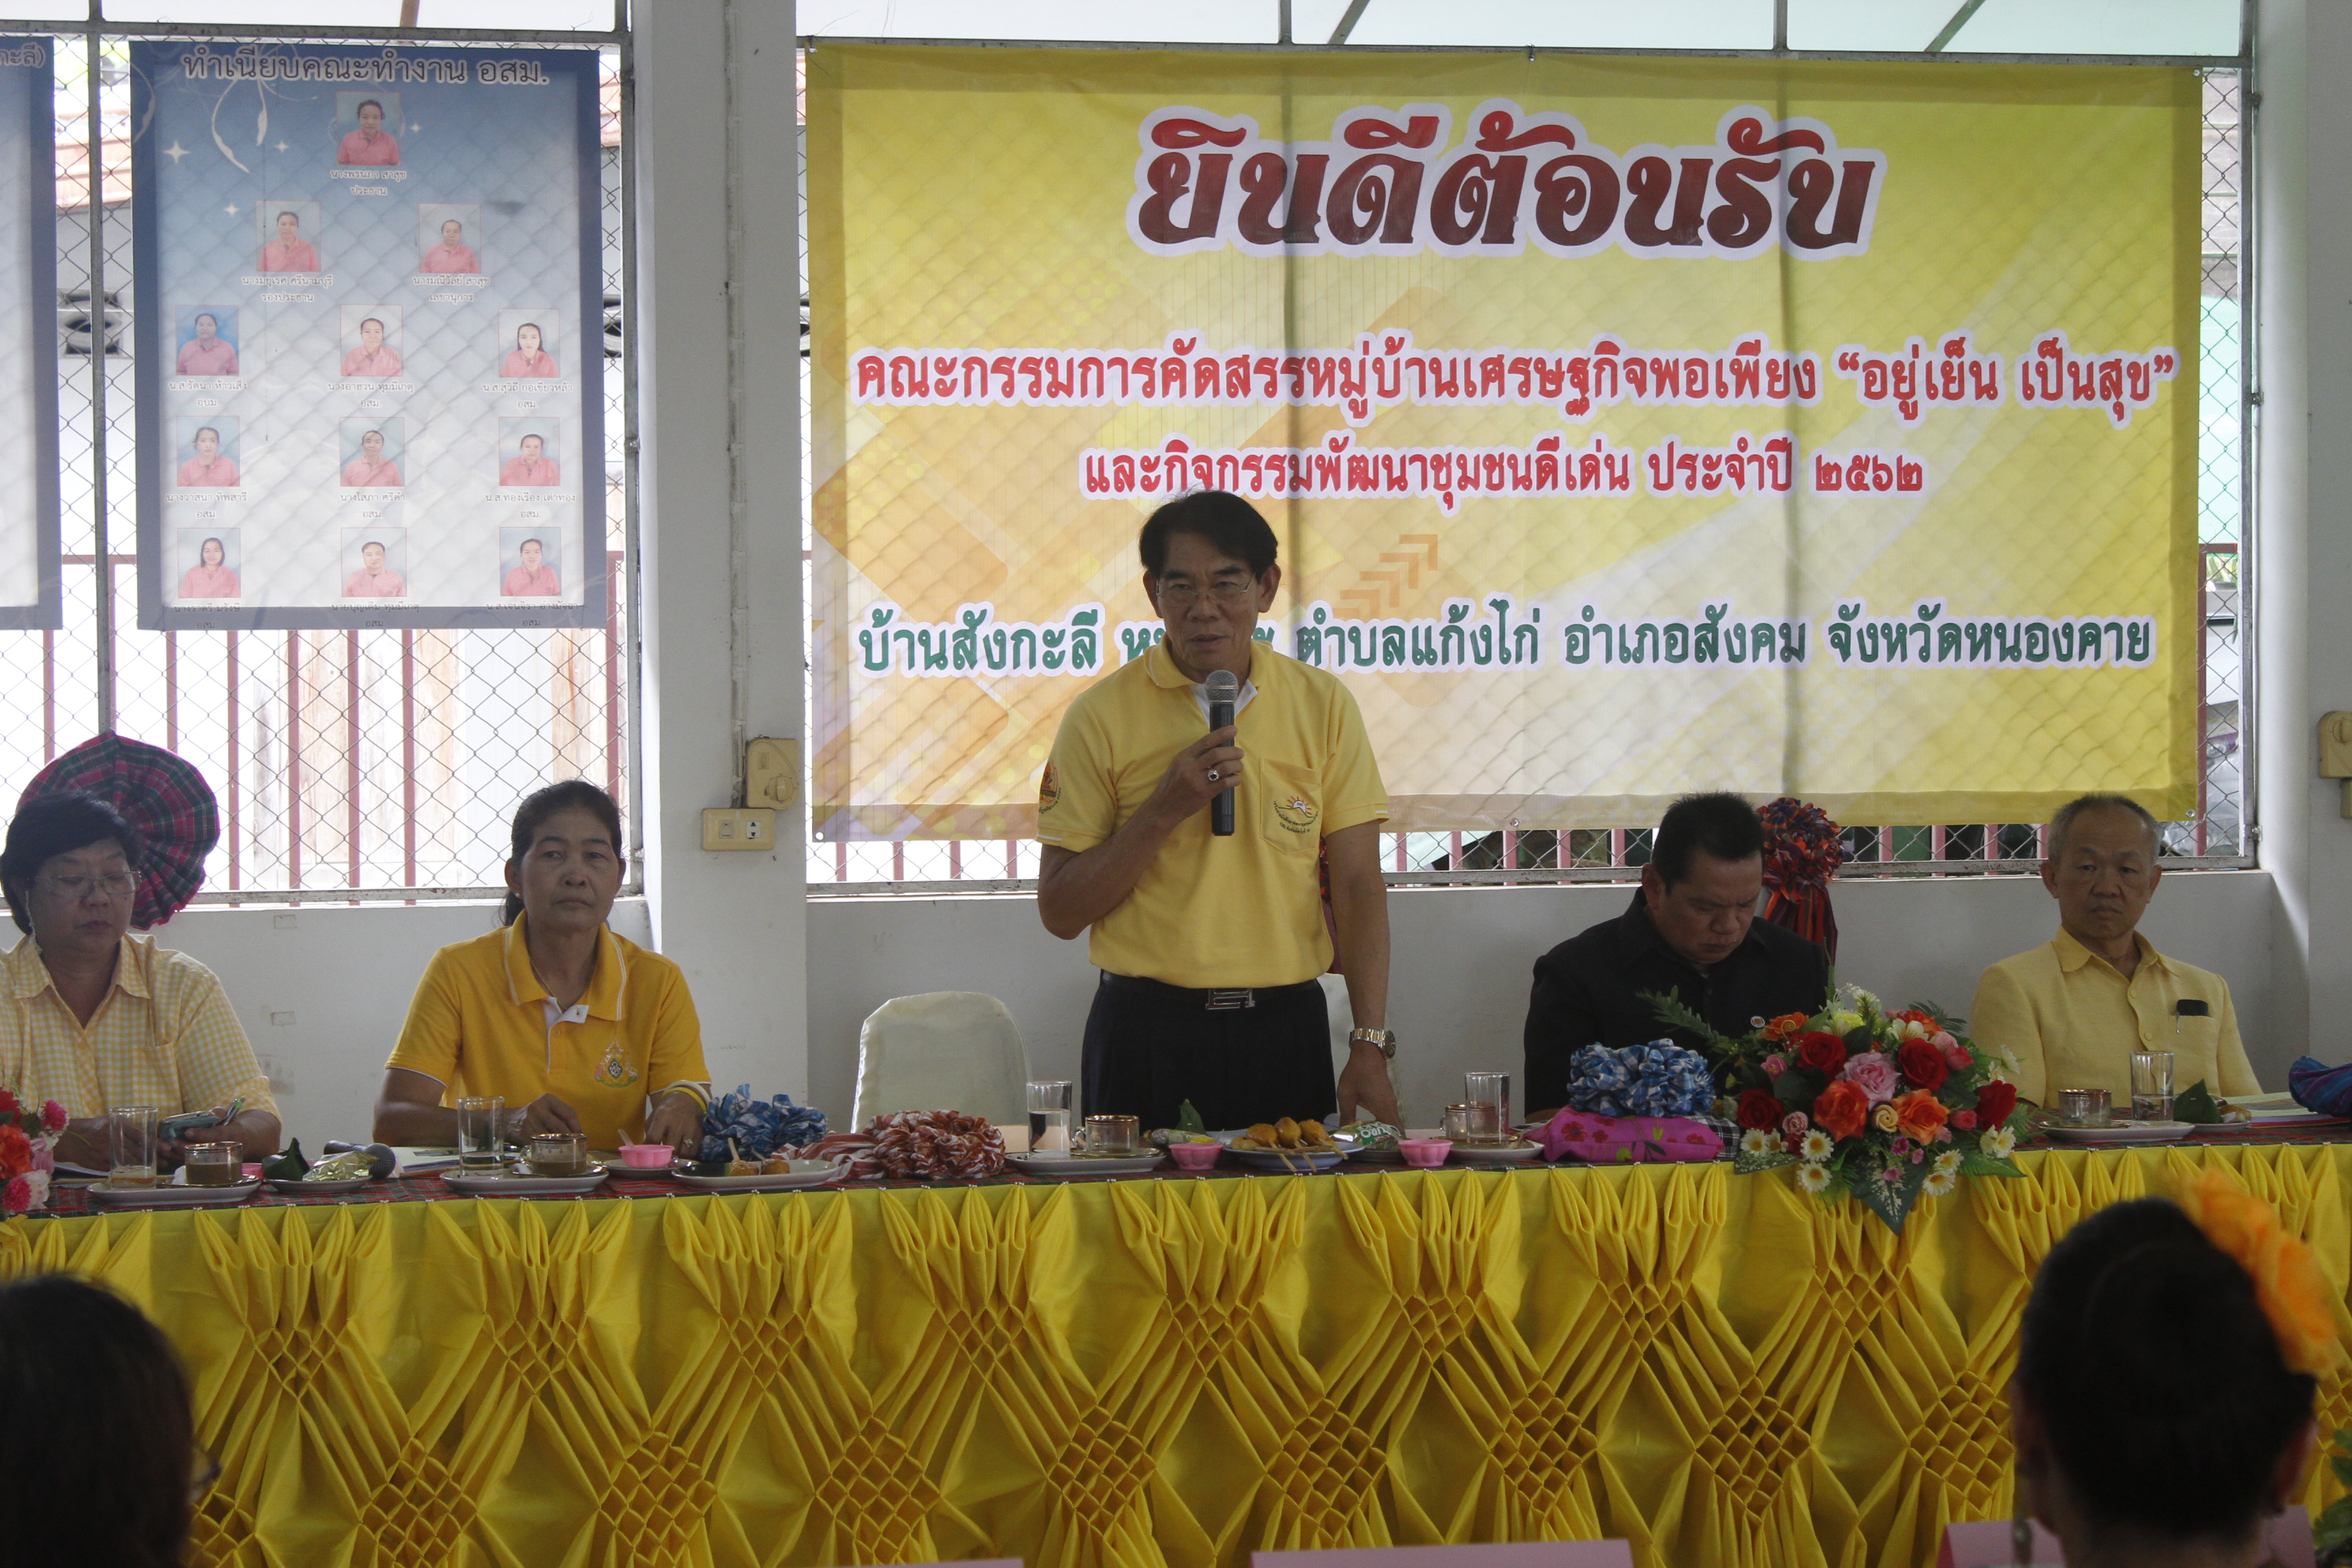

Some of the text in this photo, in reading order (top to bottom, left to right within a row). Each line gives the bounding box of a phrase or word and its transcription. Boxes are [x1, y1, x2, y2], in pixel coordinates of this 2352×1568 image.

[184, 45, 549, 83] ทำเนียบคณะทำงาน อสม.
[1137, 109, 1878, 251] ยินดีต้อนรับ
[351, 185, 387, 195] ประธาน
[261, 293, 314, 302] รองประธาน
[429, 293, 474, 305] เลขานุการ
[855, 336, 2174, 421] คณะกรรมการคัดสรรหมู่บ้านเศรษฐกิจพอเพียง “อยู่เย็น เป็นสุข”
[359, 399, 382, 408] อสม.
[517, 400, 539, 408] อสม.
[1084, 436, 1924, 510] และกิจกรรมพัฒนาชุมชนดีเด่น ประจำปี ๒๕๖๒
[167, 493, 212, 502] นางวาสนา
[196, 510, 218, 519] อสม.
[362, 510, 384, 519] อสม.
[520, 510, 542, 519] อสม.
[522, 619, 543, 627] อสม.
[1296, 598, 1539, 666] ตำบลแก้งไก่
[1565, 603, 1806, 664] อำเภอสังคม
[1828, 603, 2151, 664] จังหวัดหนองคาย
[858, 608, 1100, 671] บ้านสังกะลี
